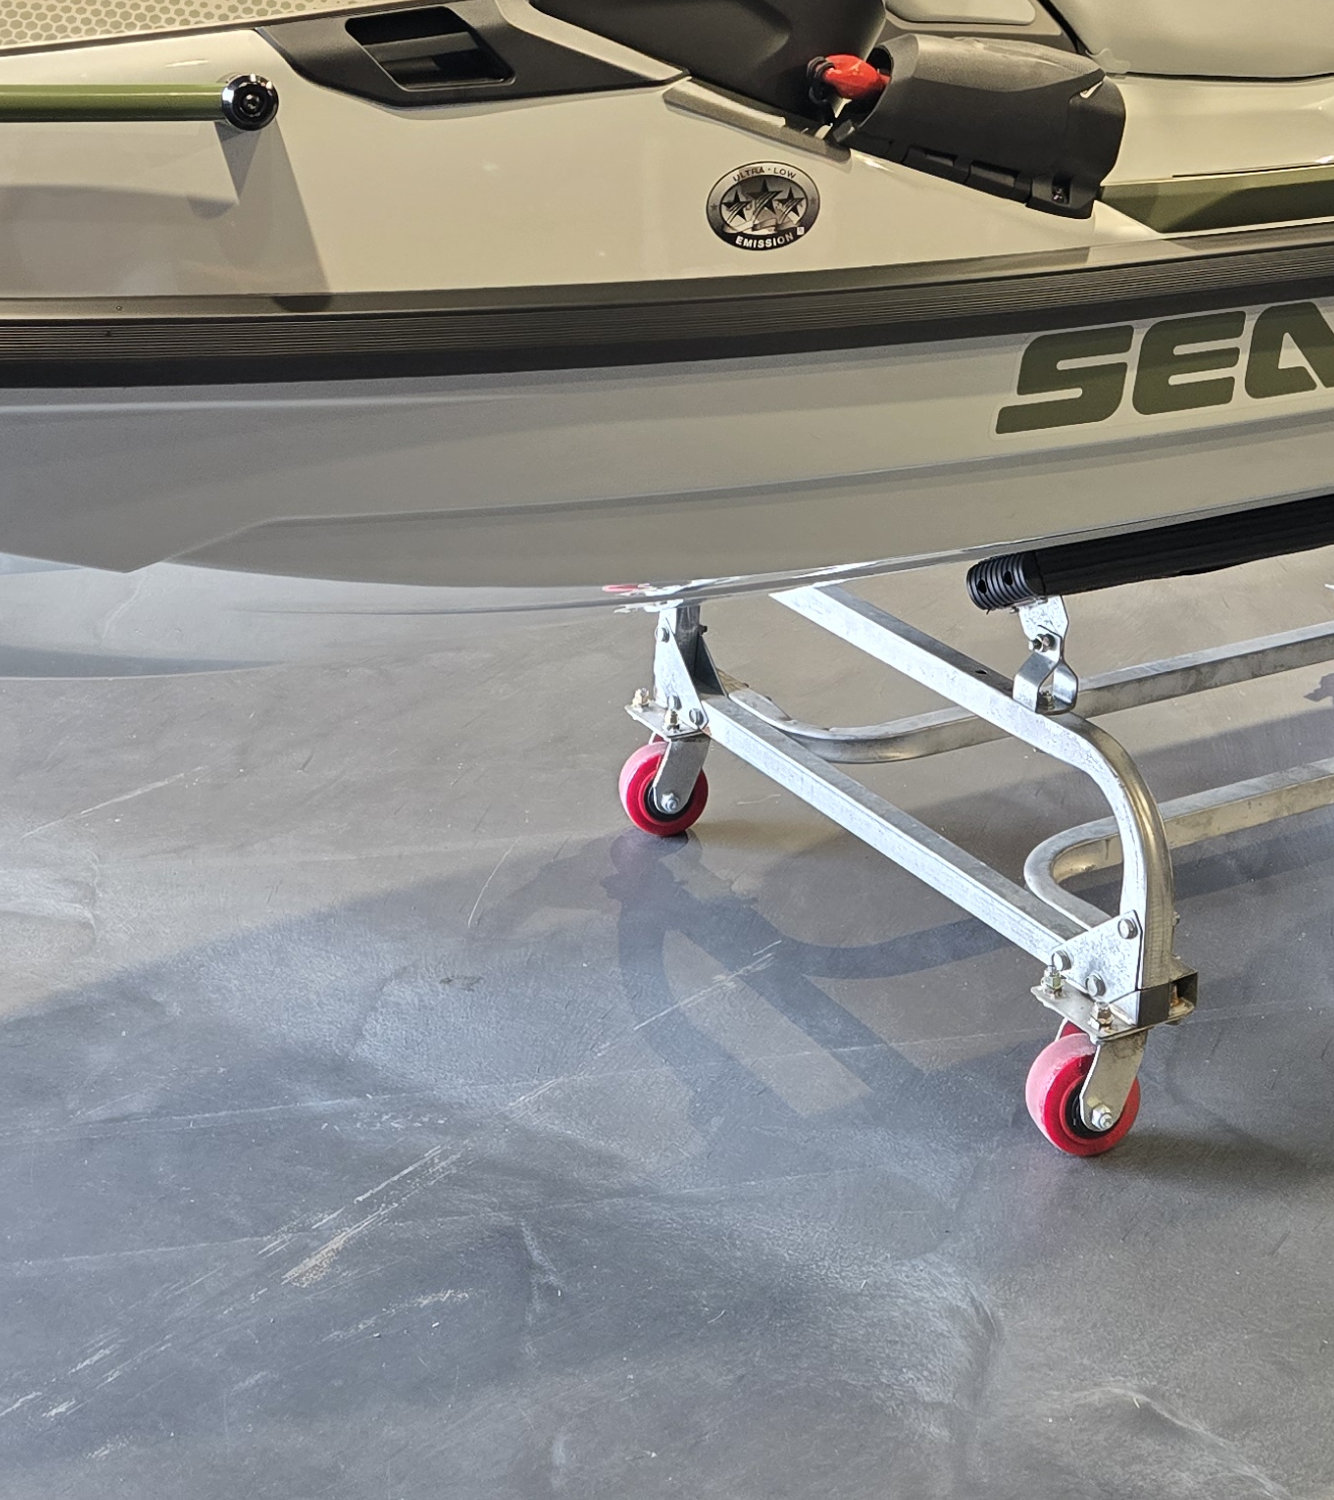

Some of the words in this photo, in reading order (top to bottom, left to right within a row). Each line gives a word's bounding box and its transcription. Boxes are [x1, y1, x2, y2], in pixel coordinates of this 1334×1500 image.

[732, 166, 765, 182] ULTRA
[773, 167, 797, 179] LOW
[735, 232, 794, 249] EMISSION
